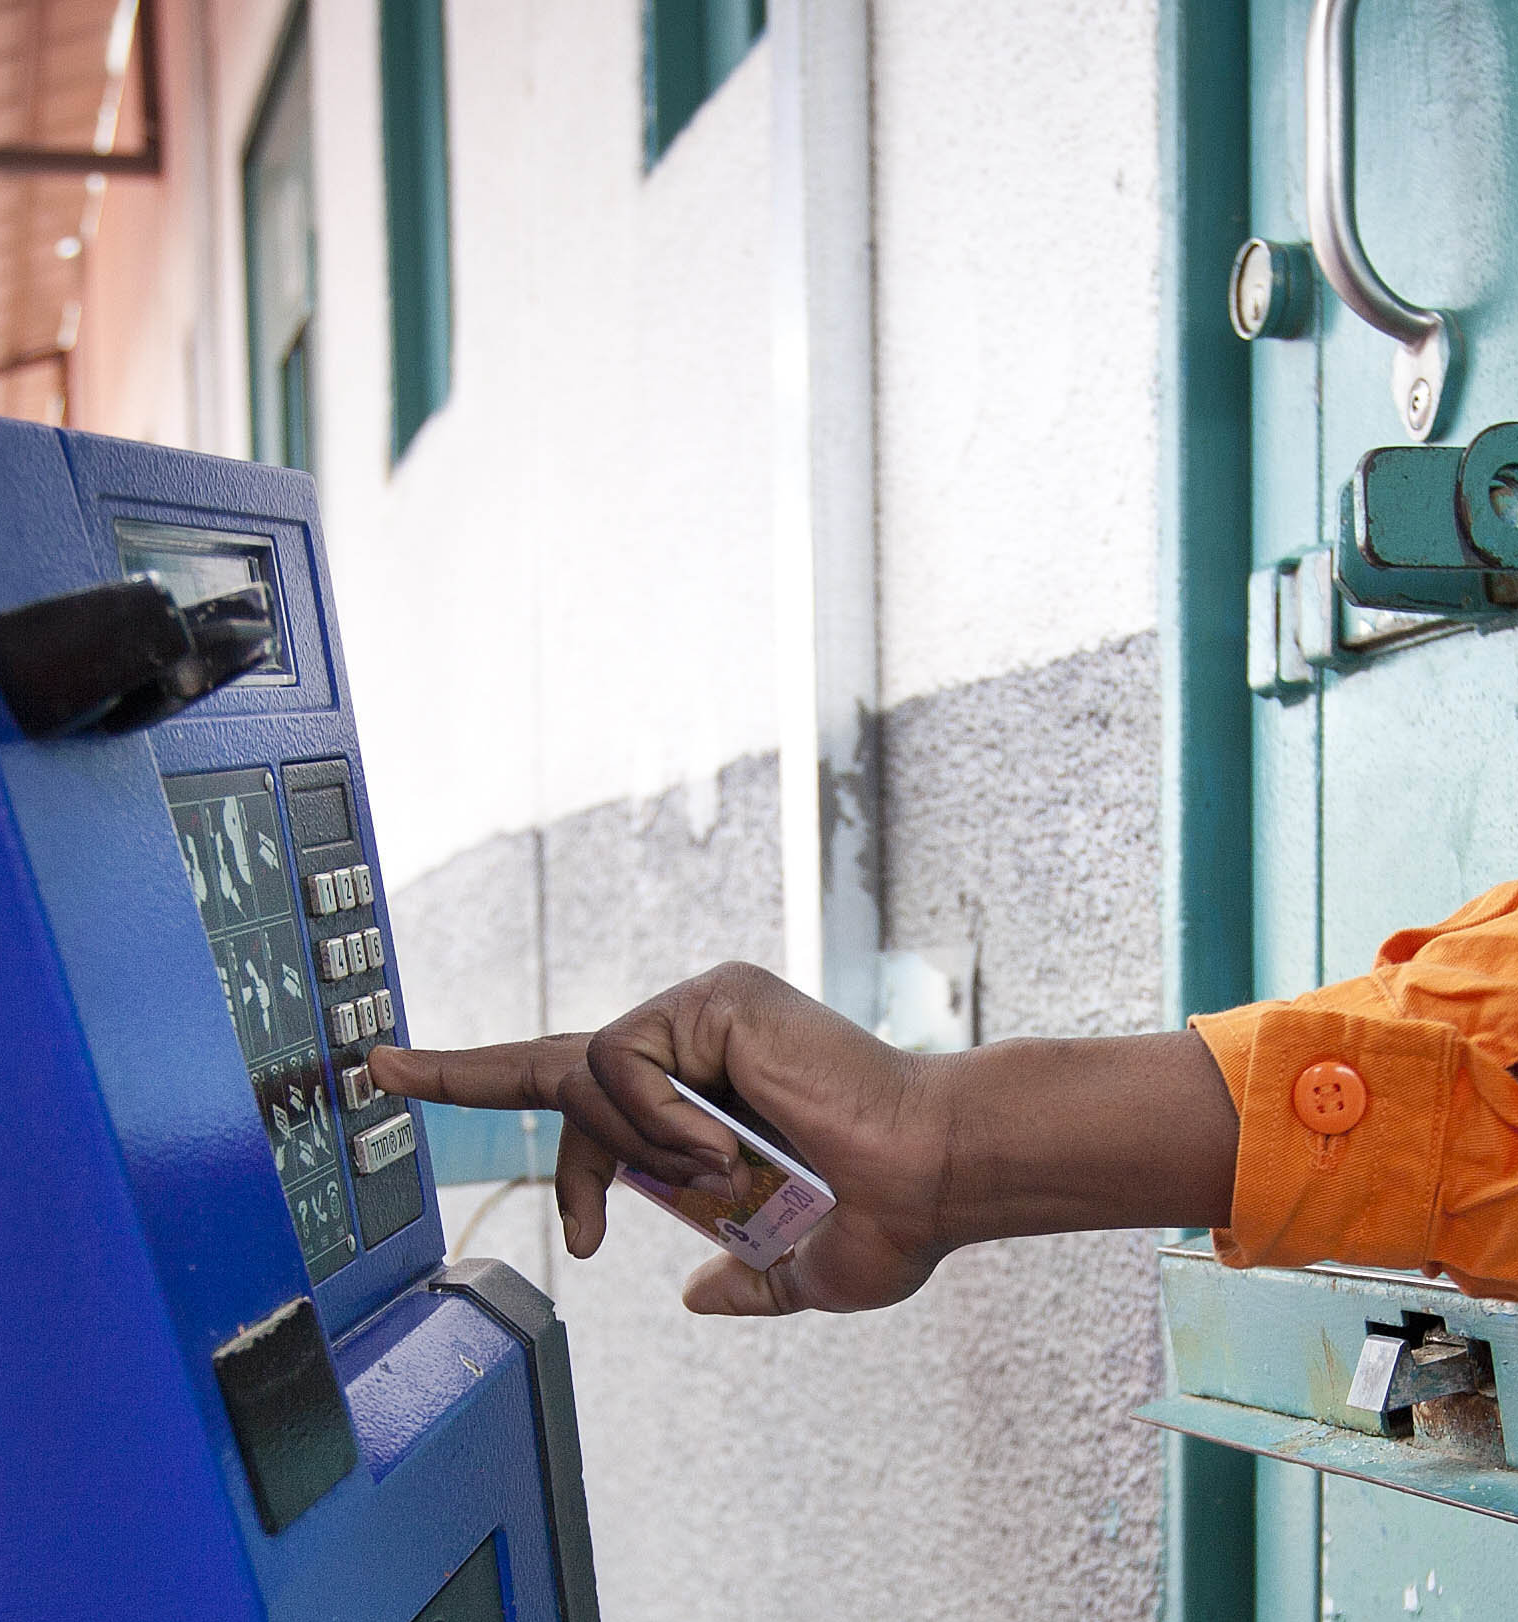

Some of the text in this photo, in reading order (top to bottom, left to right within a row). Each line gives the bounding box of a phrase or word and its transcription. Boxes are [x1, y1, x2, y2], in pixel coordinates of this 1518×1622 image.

[326, 874, 370, 904] 1 2 3
[338, 936, 380, 970] 4 5 6
[347, 999, 391, 1035] 7 8 9
[781, 1184, 814, 1211] 120
